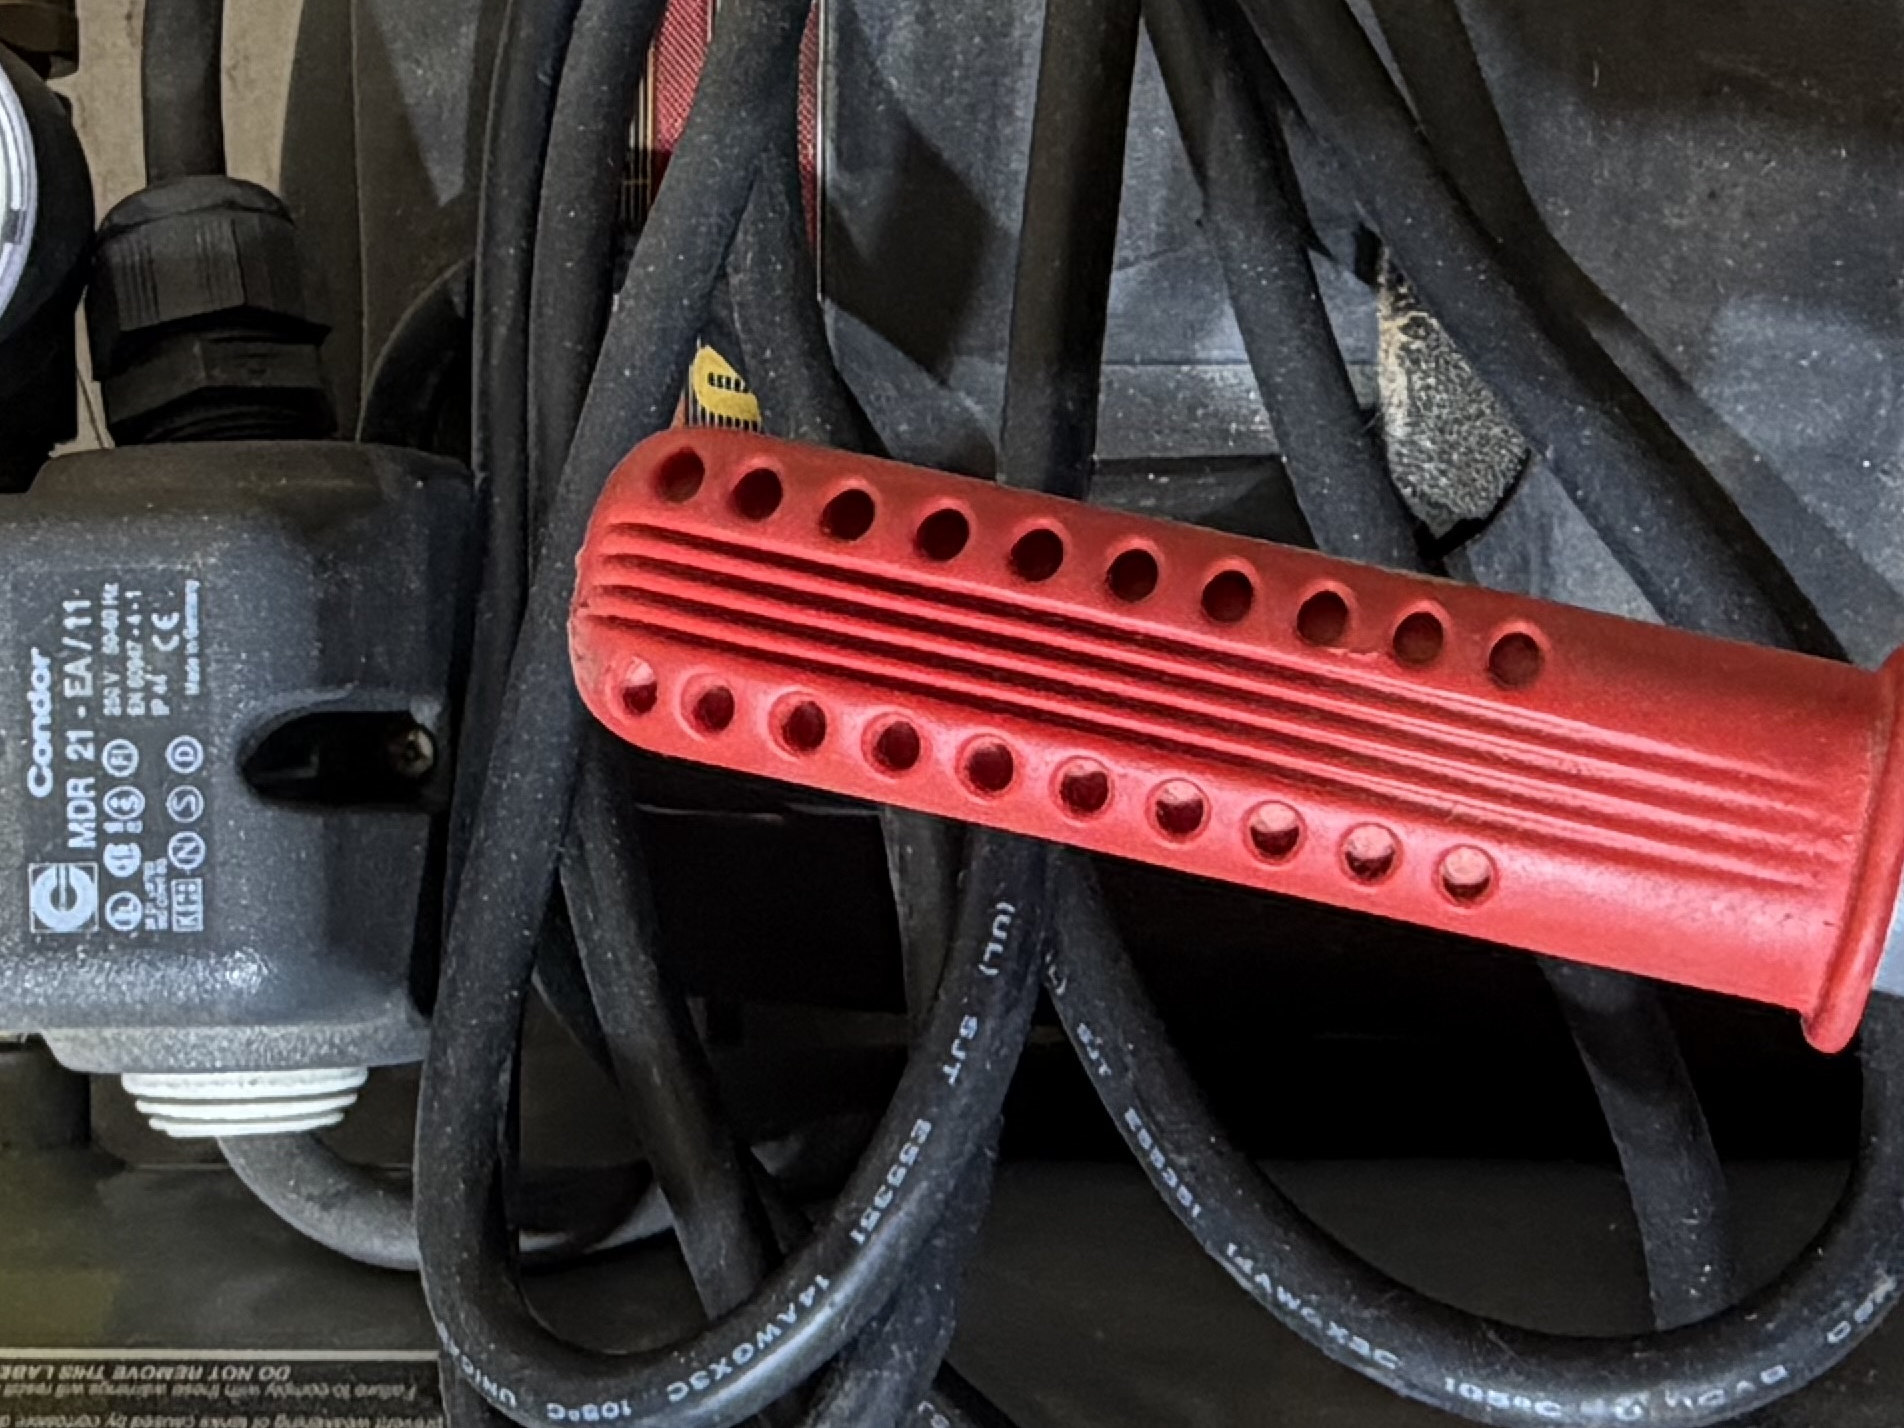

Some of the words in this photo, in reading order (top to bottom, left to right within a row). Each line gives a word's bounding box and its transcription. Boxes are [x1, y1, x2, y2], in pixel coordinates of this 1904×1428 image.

[152, 613, 180, 652] CE
[27, 647, 53, 798] Condor
[66, 731, 95, 761] 21
[66, 777, 97, 847] MDR
